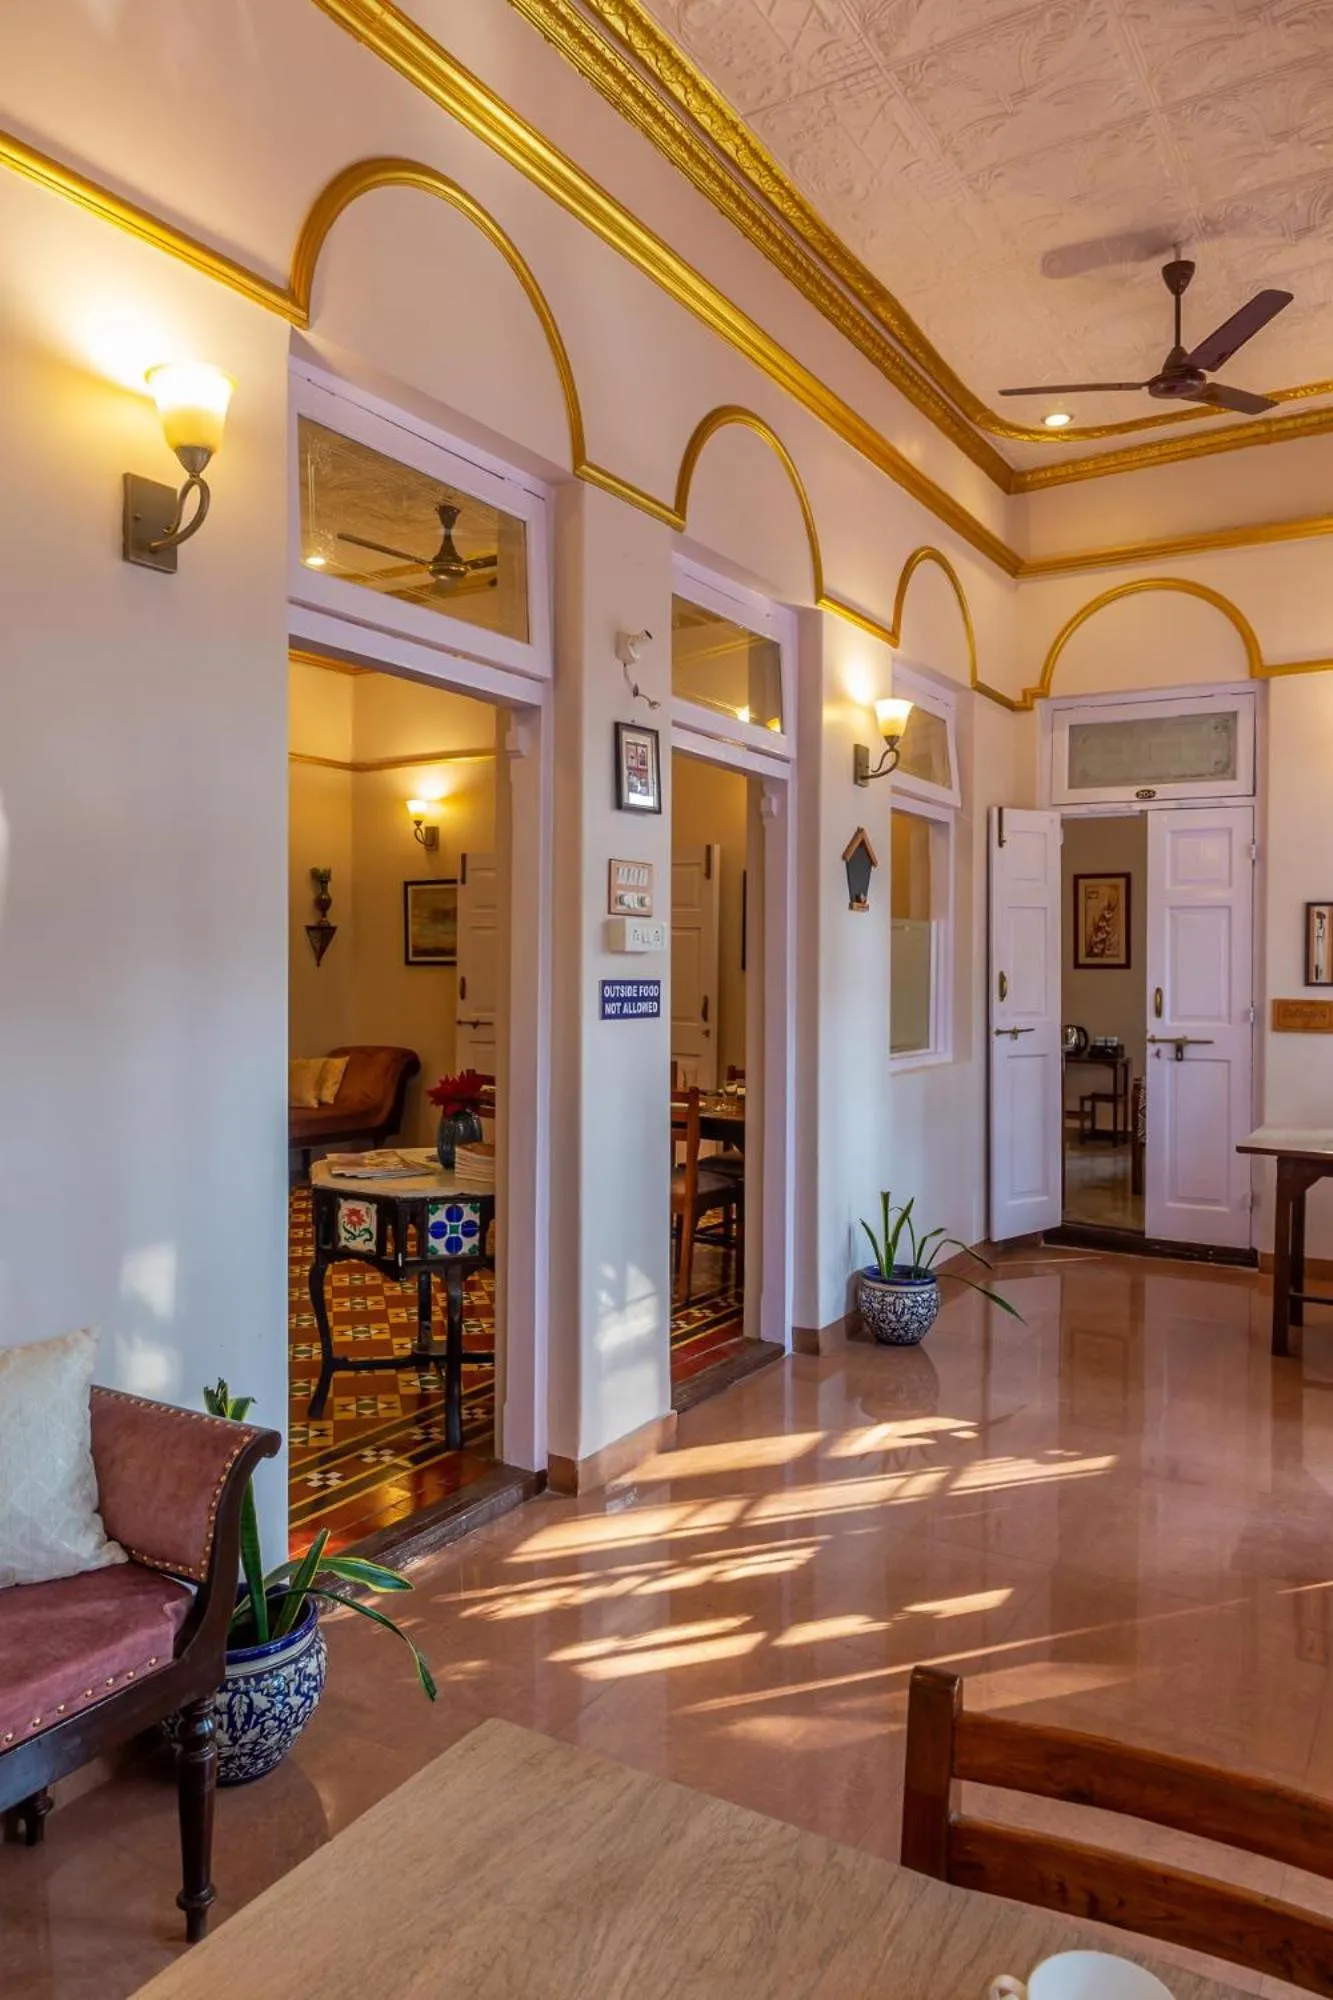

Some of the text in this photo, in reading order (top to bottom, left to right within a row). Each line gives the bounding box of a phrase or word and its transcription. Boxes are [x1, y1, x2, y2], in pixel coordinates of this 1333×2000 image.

[603, 984, 659, 998] OUTSIDE FOOD
[604, 1001, 658, 1015] NOT ALLOWED
